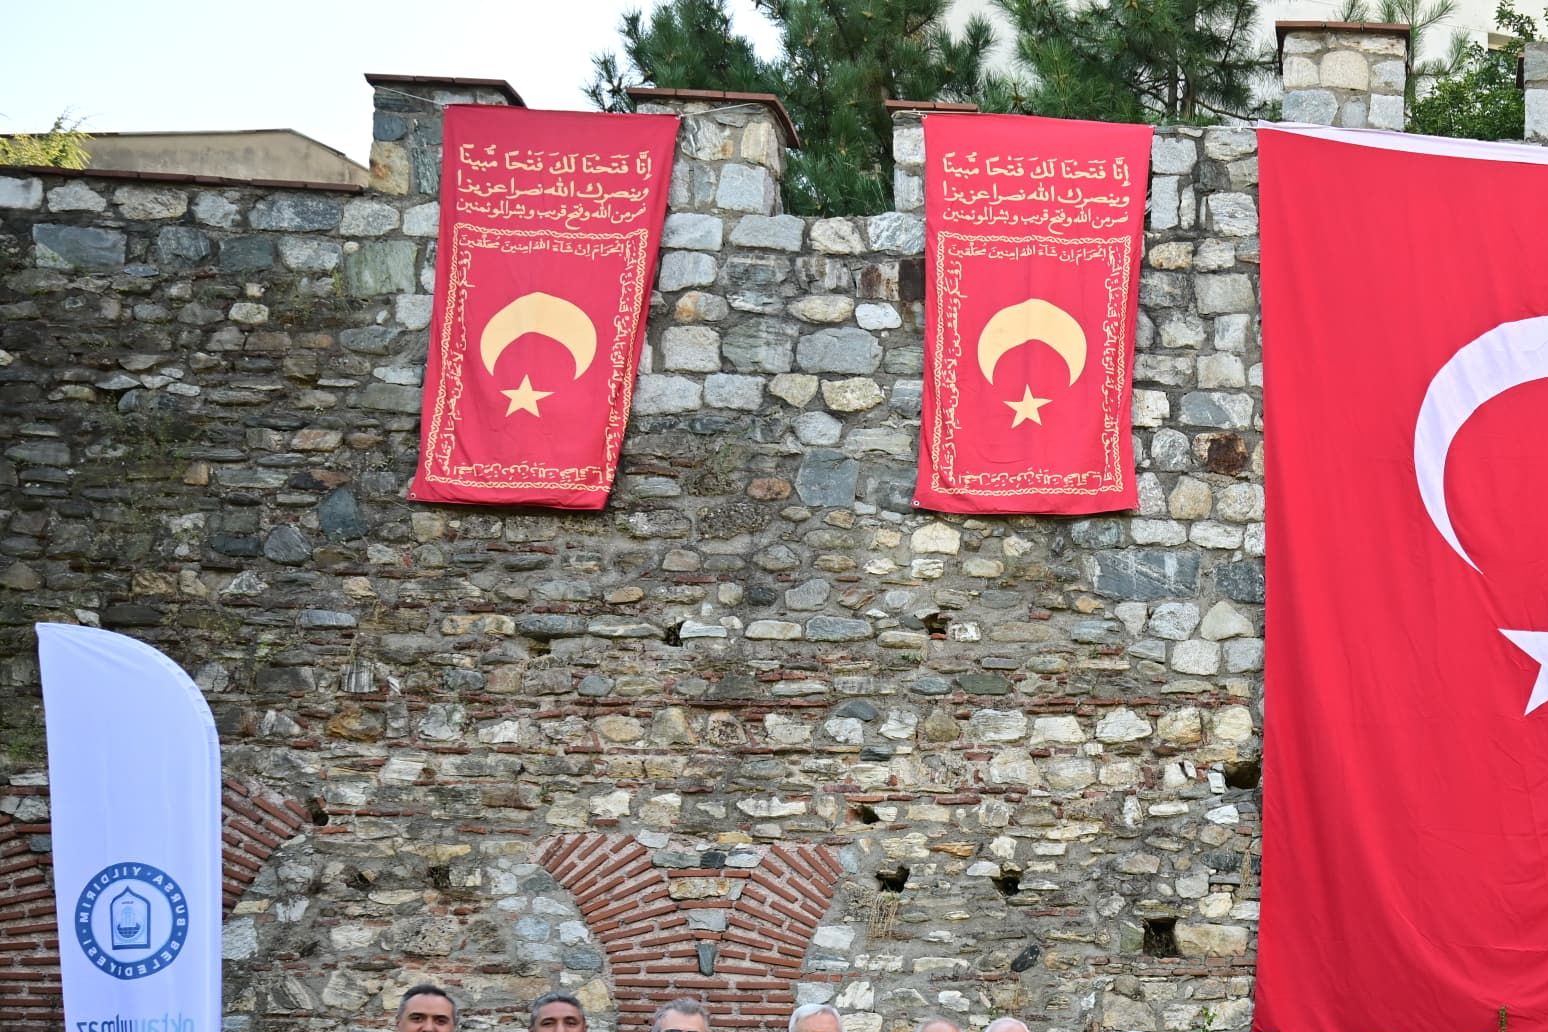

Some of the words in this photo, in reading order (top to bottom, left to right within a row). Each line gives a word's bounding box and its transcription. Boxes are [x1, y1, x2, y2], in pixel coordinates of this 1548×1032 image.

[457, 170, 506, 196] عزيزا
[506, 177, 543, 198] نصرا
[544, 178, 574, 197] الله
[943, 181, 989, 204] عزيزا
[1028, 183, 1054, 201] الله
[989, 184, 1026, 204] نصرا
[592, 203, 611, 218] الله
[1074, 208, 1091, 223] الله
